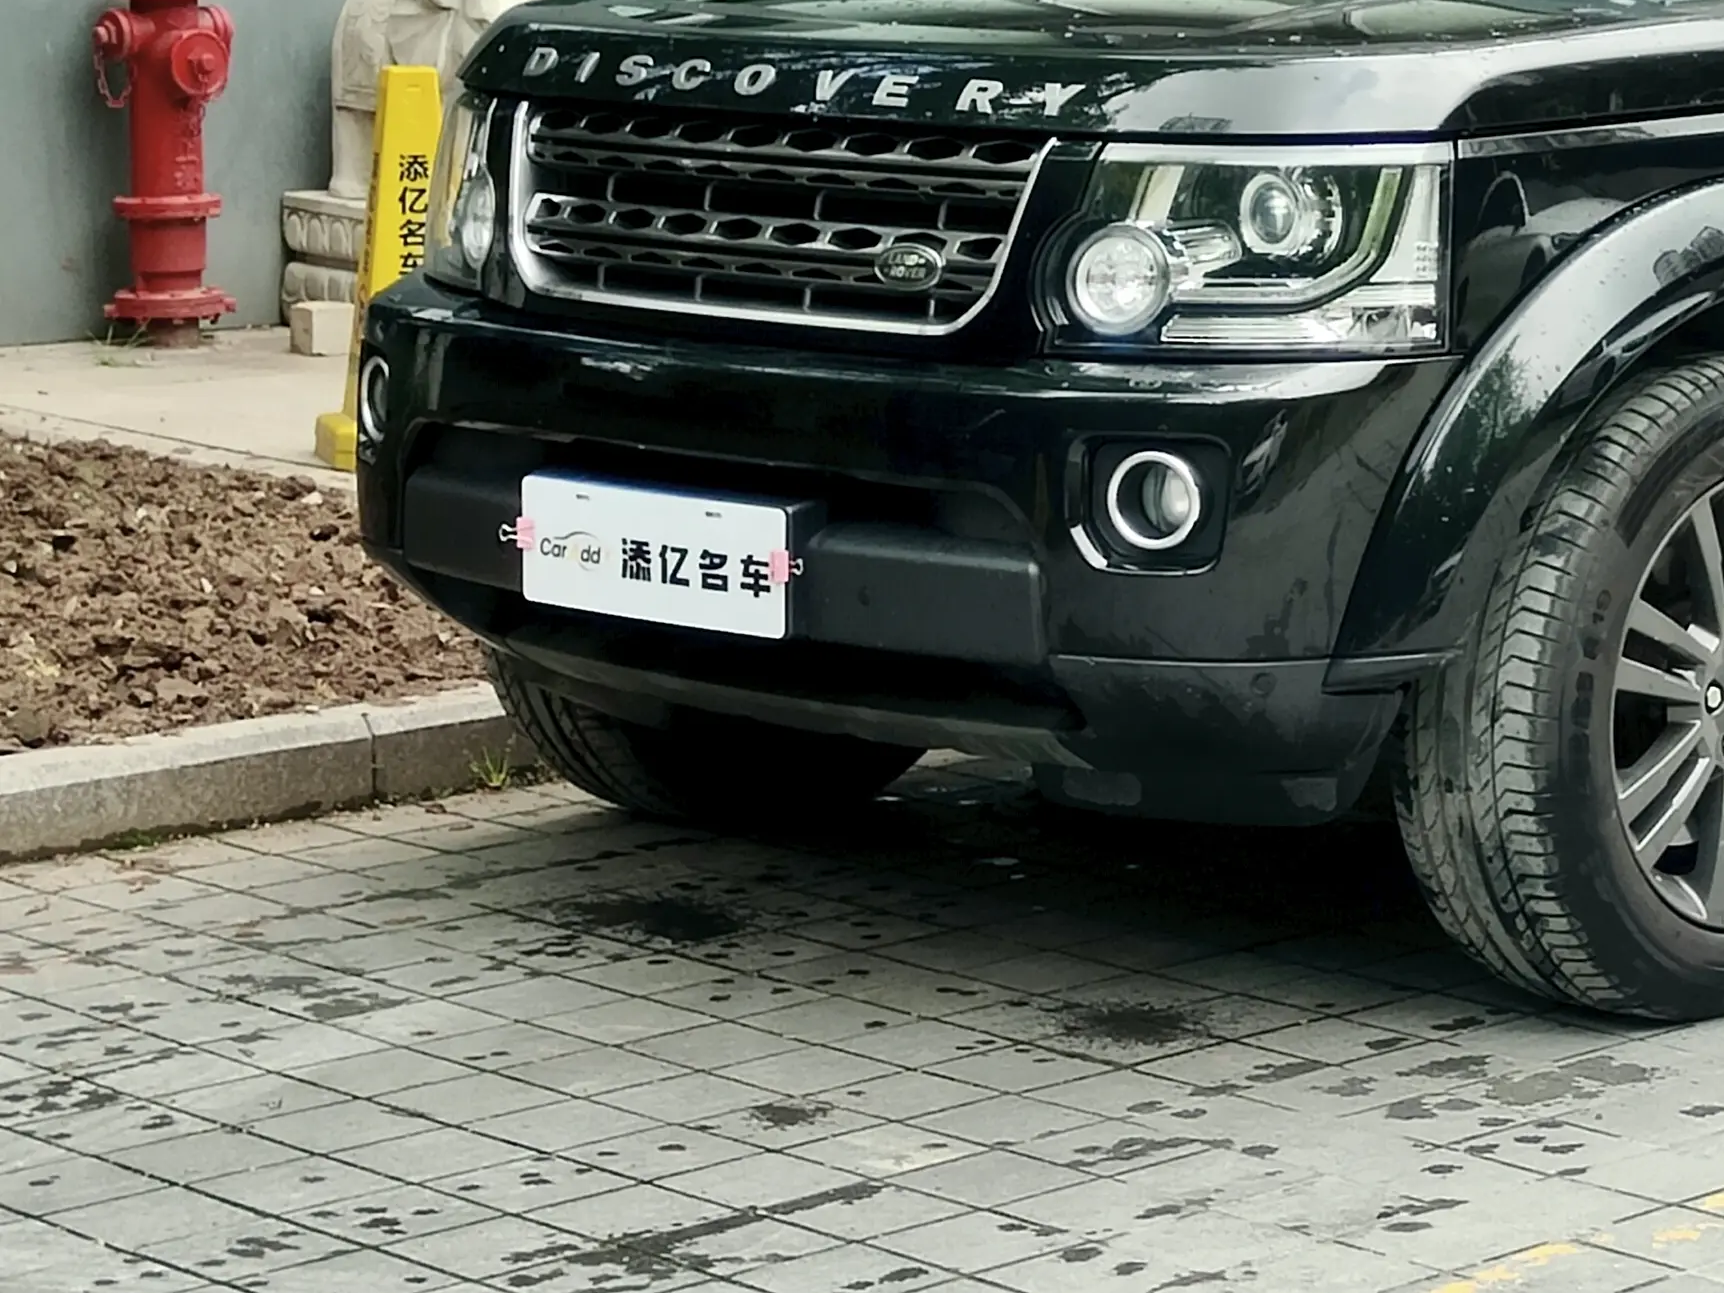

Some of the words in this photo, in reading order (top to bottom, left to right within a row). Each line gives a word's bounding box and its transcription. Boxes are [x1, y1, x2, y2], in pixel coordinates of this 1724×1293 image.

[522, 46, 1086, 117] DISCOVERY
[621, 538, 770, 597] 添亿名车
